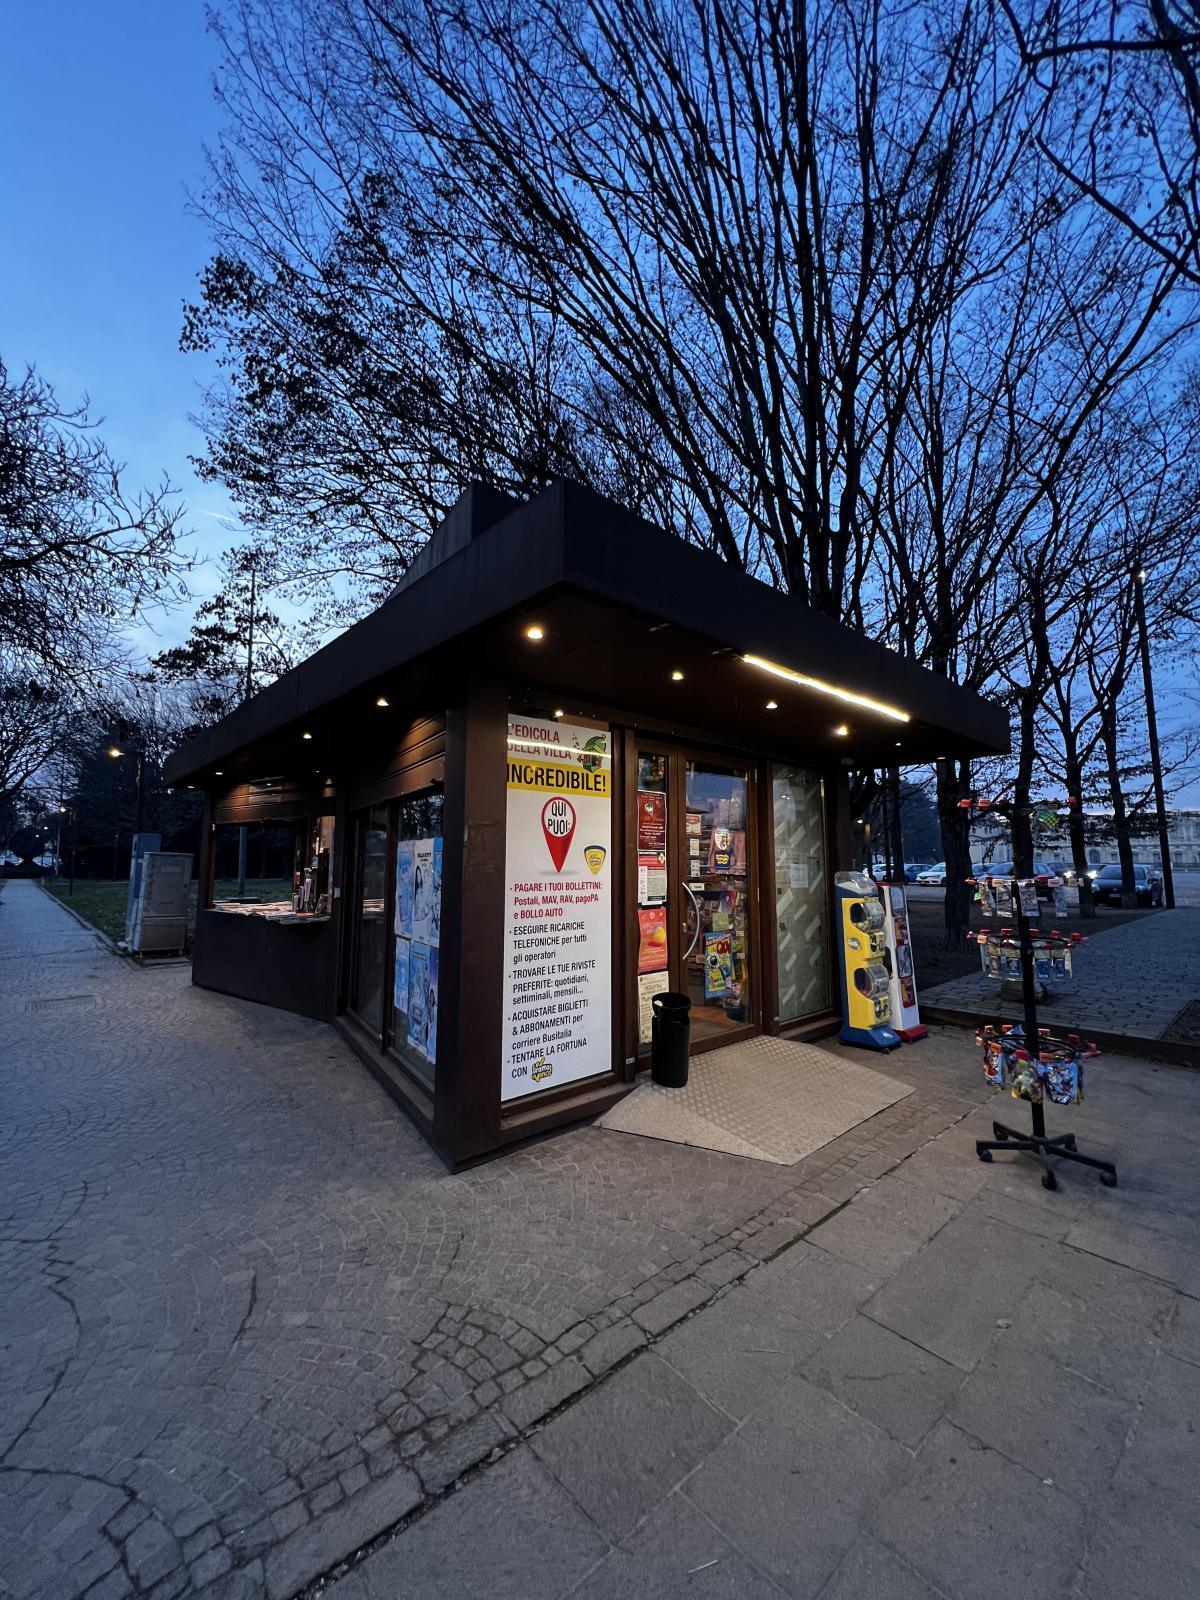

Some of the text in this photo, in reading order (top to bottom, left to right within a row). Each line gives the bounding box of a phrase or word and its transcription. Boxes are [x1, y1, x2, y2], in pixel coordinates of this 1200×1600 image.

[544, 746, 571, 760] VILLA
[507, 763, 605, 792] INCREDIBILE!
[551, 800, 567, 817] QUI
[547, 818, 570, 835] PUOI:
[514, 881, 603, 892] PAGARE I TUOI BOLLETTINI:
[514, 893, 599, 906] Postali, MAV, RAV, pagoPA
[520, 909, 543, 919] BOLLO
[544, 907, 563, 917] AUTO
[513, 921, 585, 936] ESEGUIRE RICARICHE
[513, 934, 587, 949] TELEFONICHE per tutti
[513, 949, 556, 965] gli operatori
[512, 959, 596, 980] TROVARE LE TUE RIVISTE
[512, 973, 589, 994] PREFERITE: quotidiani,
[512, 990, 552, 1005] settiminali,
[512, 999, 589, 1022] ACQUISTARE BIGLIETTI
[512, 1013, 583, 1036] & ABBONAMENTI per
[512, 1028, 572, 1050] corriere Busitalia
[511, 1037, 587, 1064] TENTARE LA FORTUNA
[511, 1065, 528, 1079] CON
